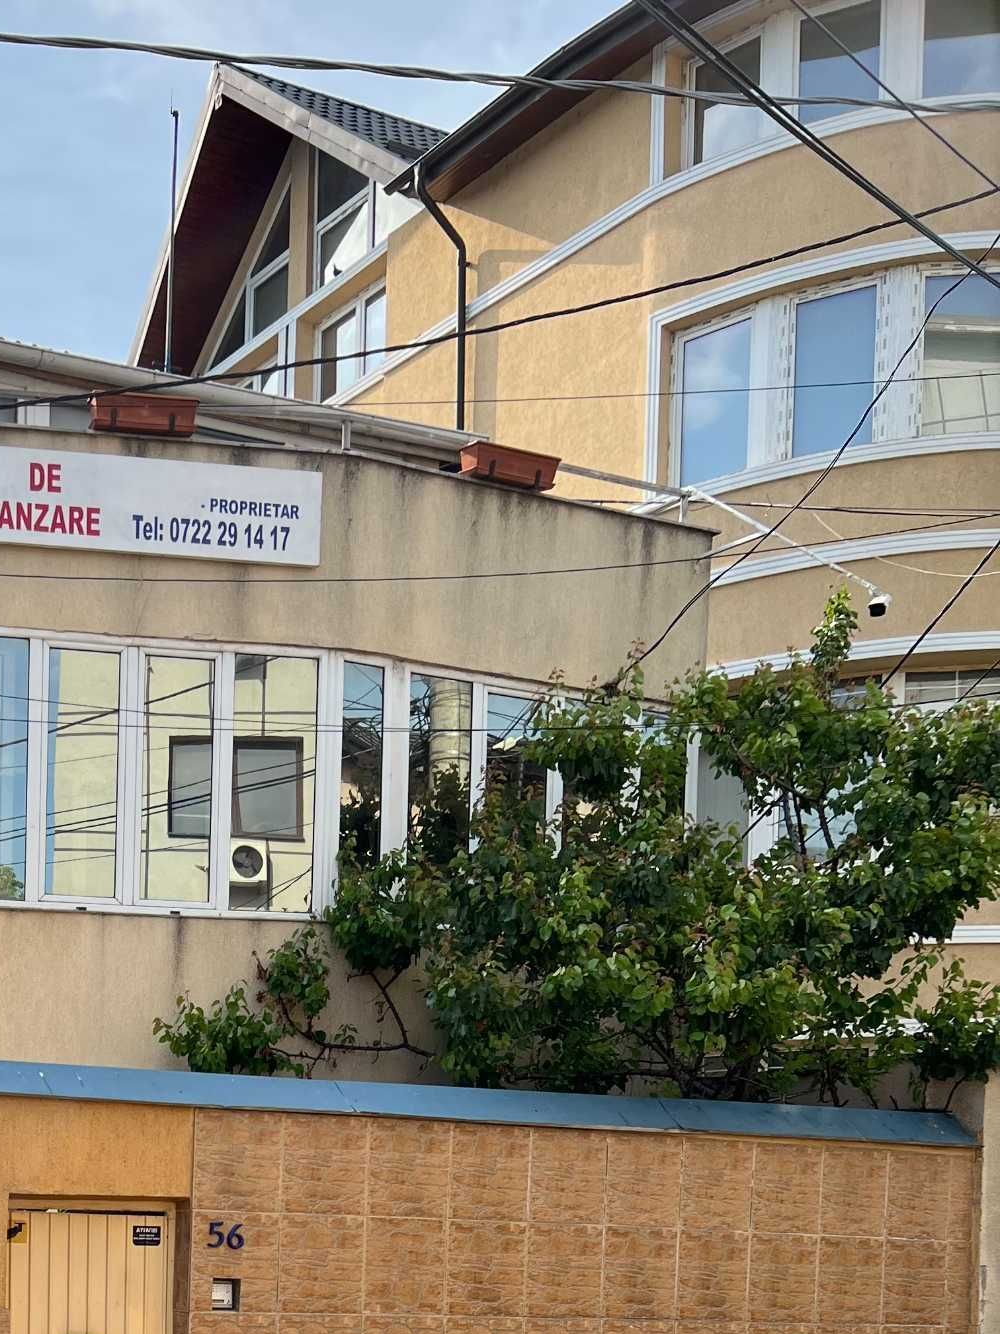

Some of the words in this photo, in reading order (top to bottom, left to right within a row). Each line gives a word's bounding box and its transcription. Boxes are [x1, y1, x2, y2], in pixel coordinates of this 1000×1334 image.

[29, 462, 62, 494] DE
[209, 497, 300, 520] PROPRIETAR
[132, 514, 164, 542] Tel:
[169, 517, 212, 546] 0722
[217, 520, 239, 548] 29
[244, 523, 264, 550] 14
[270, 525, 290, 552] 17
[206, 1221, 245, 1251] 56
